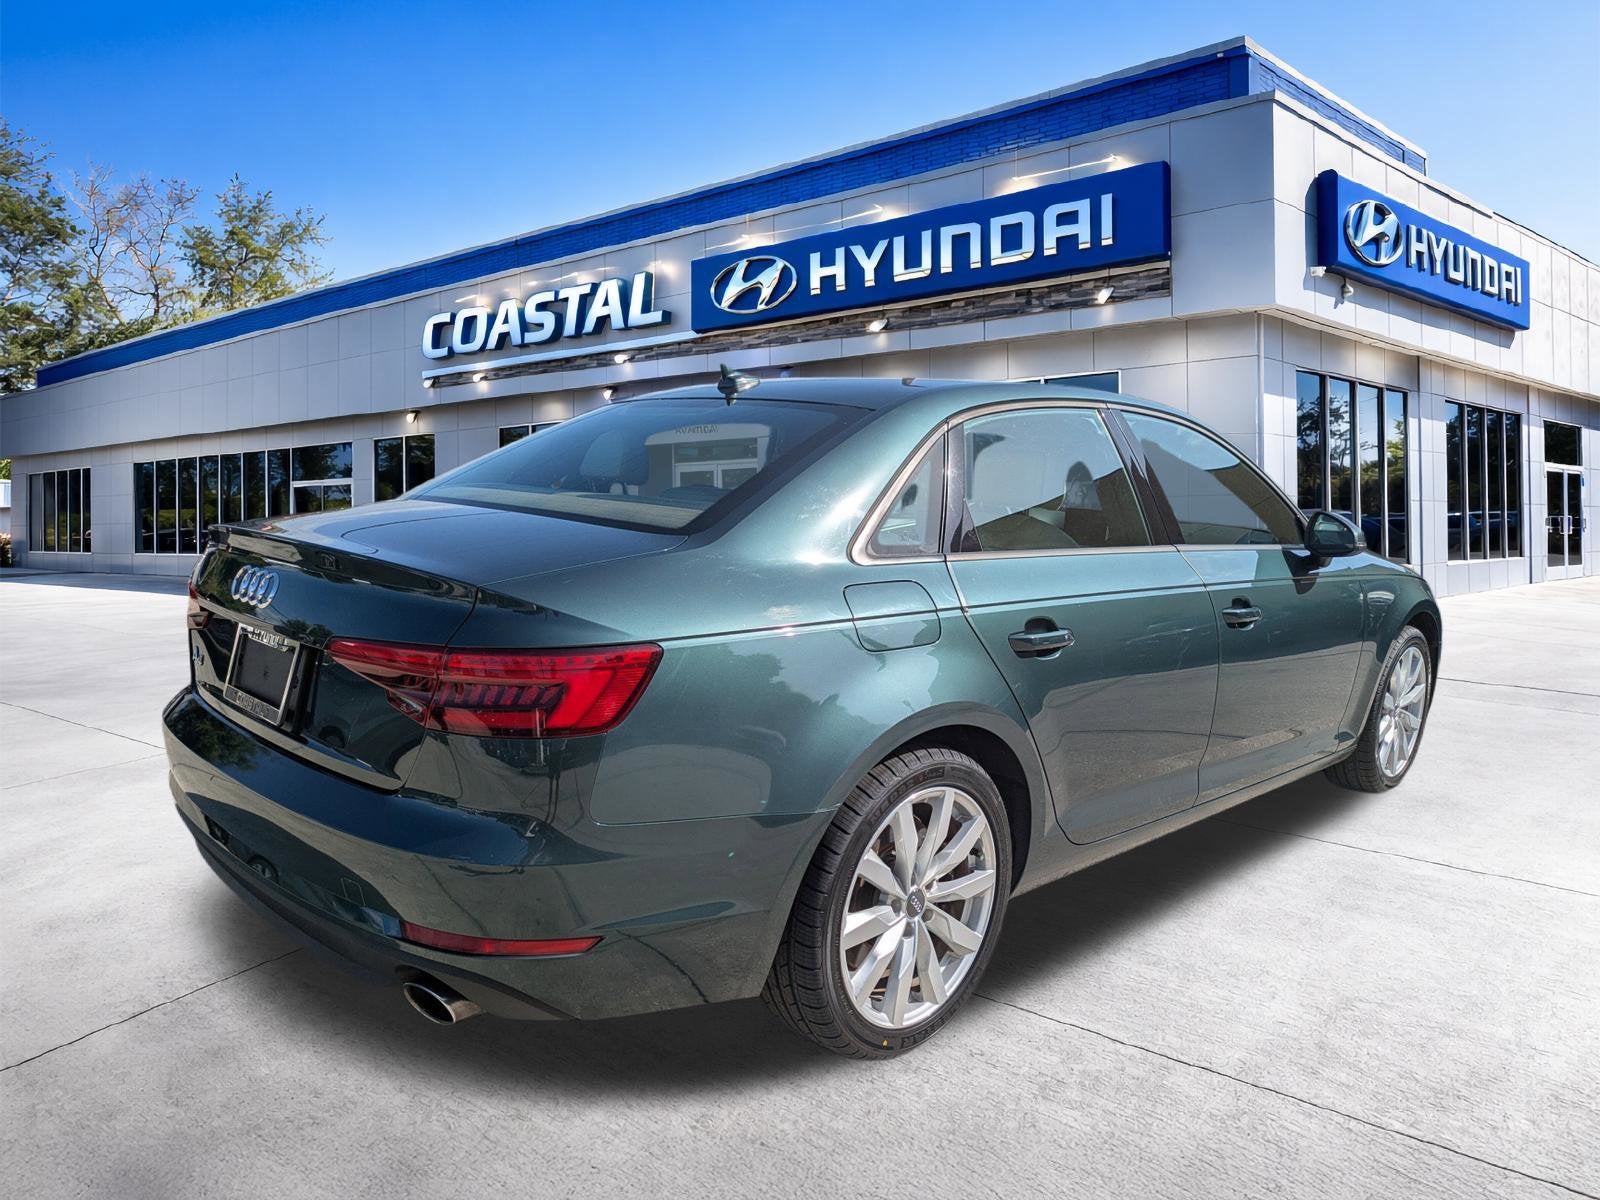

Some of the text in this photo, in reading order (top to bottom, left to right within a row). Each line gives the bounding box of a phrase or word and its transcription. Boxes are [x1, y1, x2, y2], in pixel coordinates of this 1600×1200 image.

[809, 192, 1113, 296] HYUNDAI
[1406, 223, 1522, 307] HYUNDAI
[422, 271, 671, 360] COASTAL
